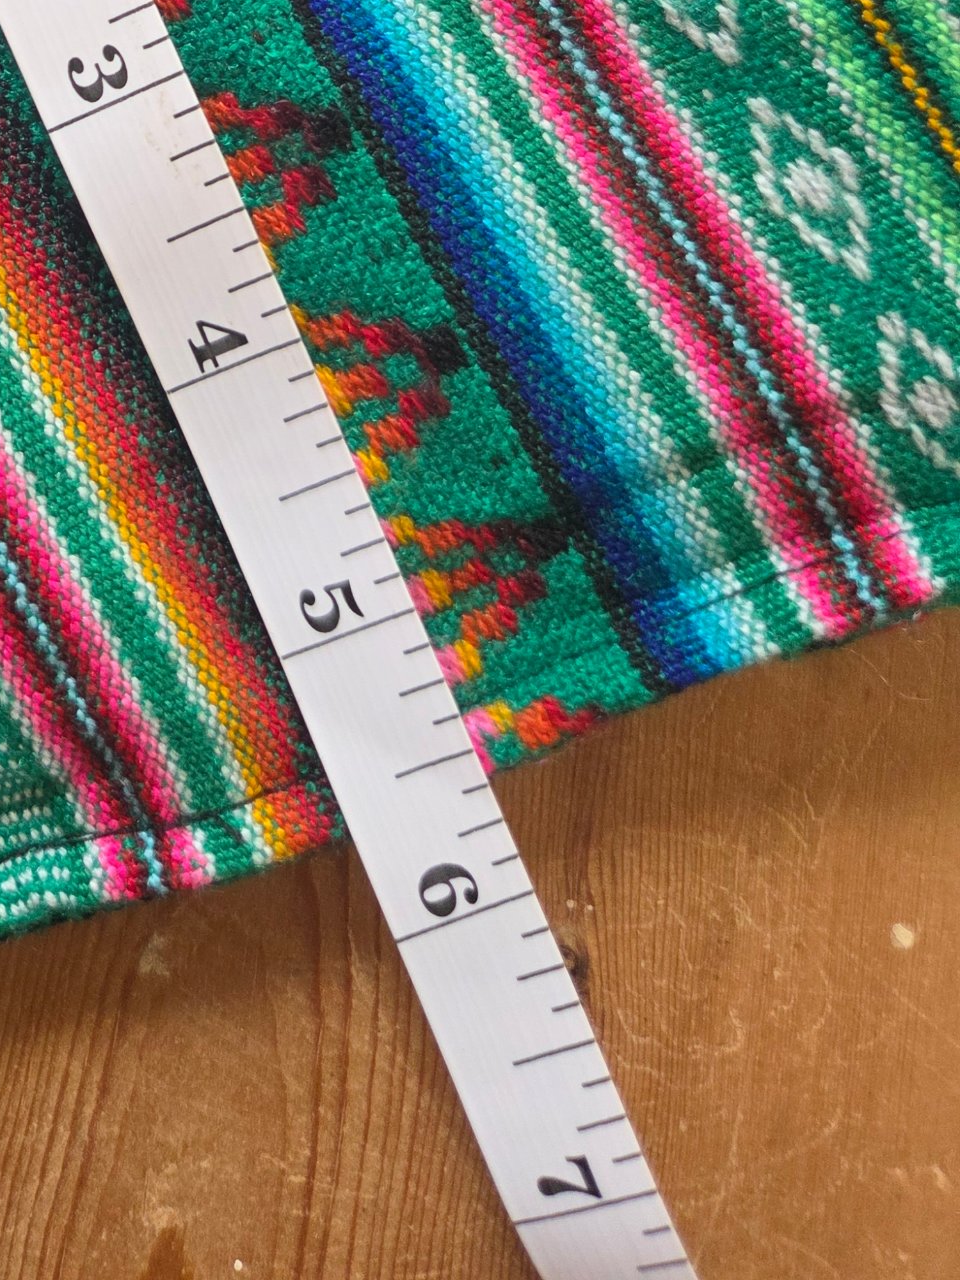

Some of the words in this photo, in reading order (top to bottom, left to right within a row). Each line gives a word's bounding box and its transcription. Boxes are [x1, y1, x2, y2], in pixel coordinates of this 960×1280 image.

[68, 44, 128, 102] 3
[187, 319, 248, 373] 4
[299, 579, 365, 633] 5
[418, 862, 478, 918] 6
[537, 1155, 602, 1199] 7
